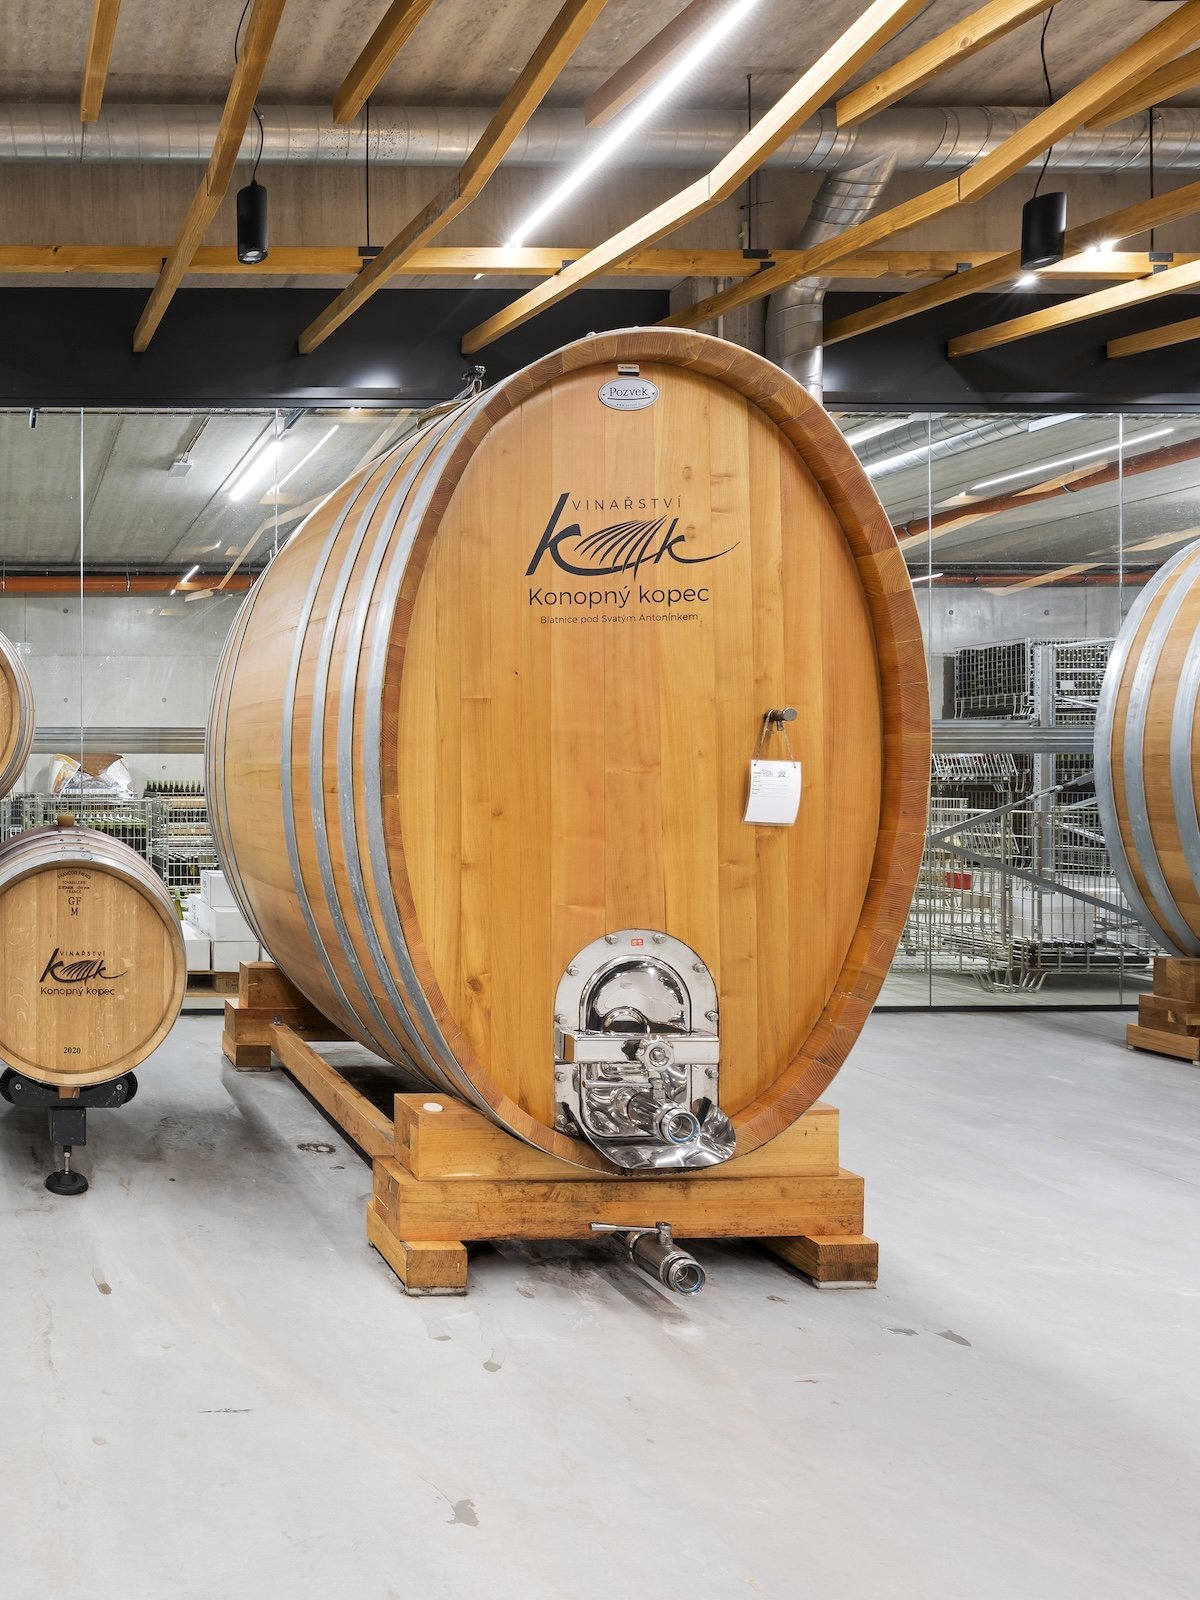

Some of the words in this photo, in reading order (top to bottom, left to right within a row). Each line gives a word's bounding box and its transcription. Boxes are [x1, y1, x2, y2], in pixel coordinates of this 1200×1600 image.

[609, 387, 648, 397] Pozvek
[572, 496, 682, 511] VINAŘSTVÍ
[528, 585, 631, 609] Konopný
[639, 585, 710, 607] kopec
[540, 616, 578, 624] Blatnice
[580, 615, 599, 625] pod
[601, 614, 636, 624] Svatým
[638, 612, 699, 622] Antonínkem
[68, 896, 81, 905] GF
[70, 907, 79, 916] M
[40, 987, 84, 997] Konopný
[86, 986, 115, 996] kopec
[63, 1046, 81, 1055] 2020
